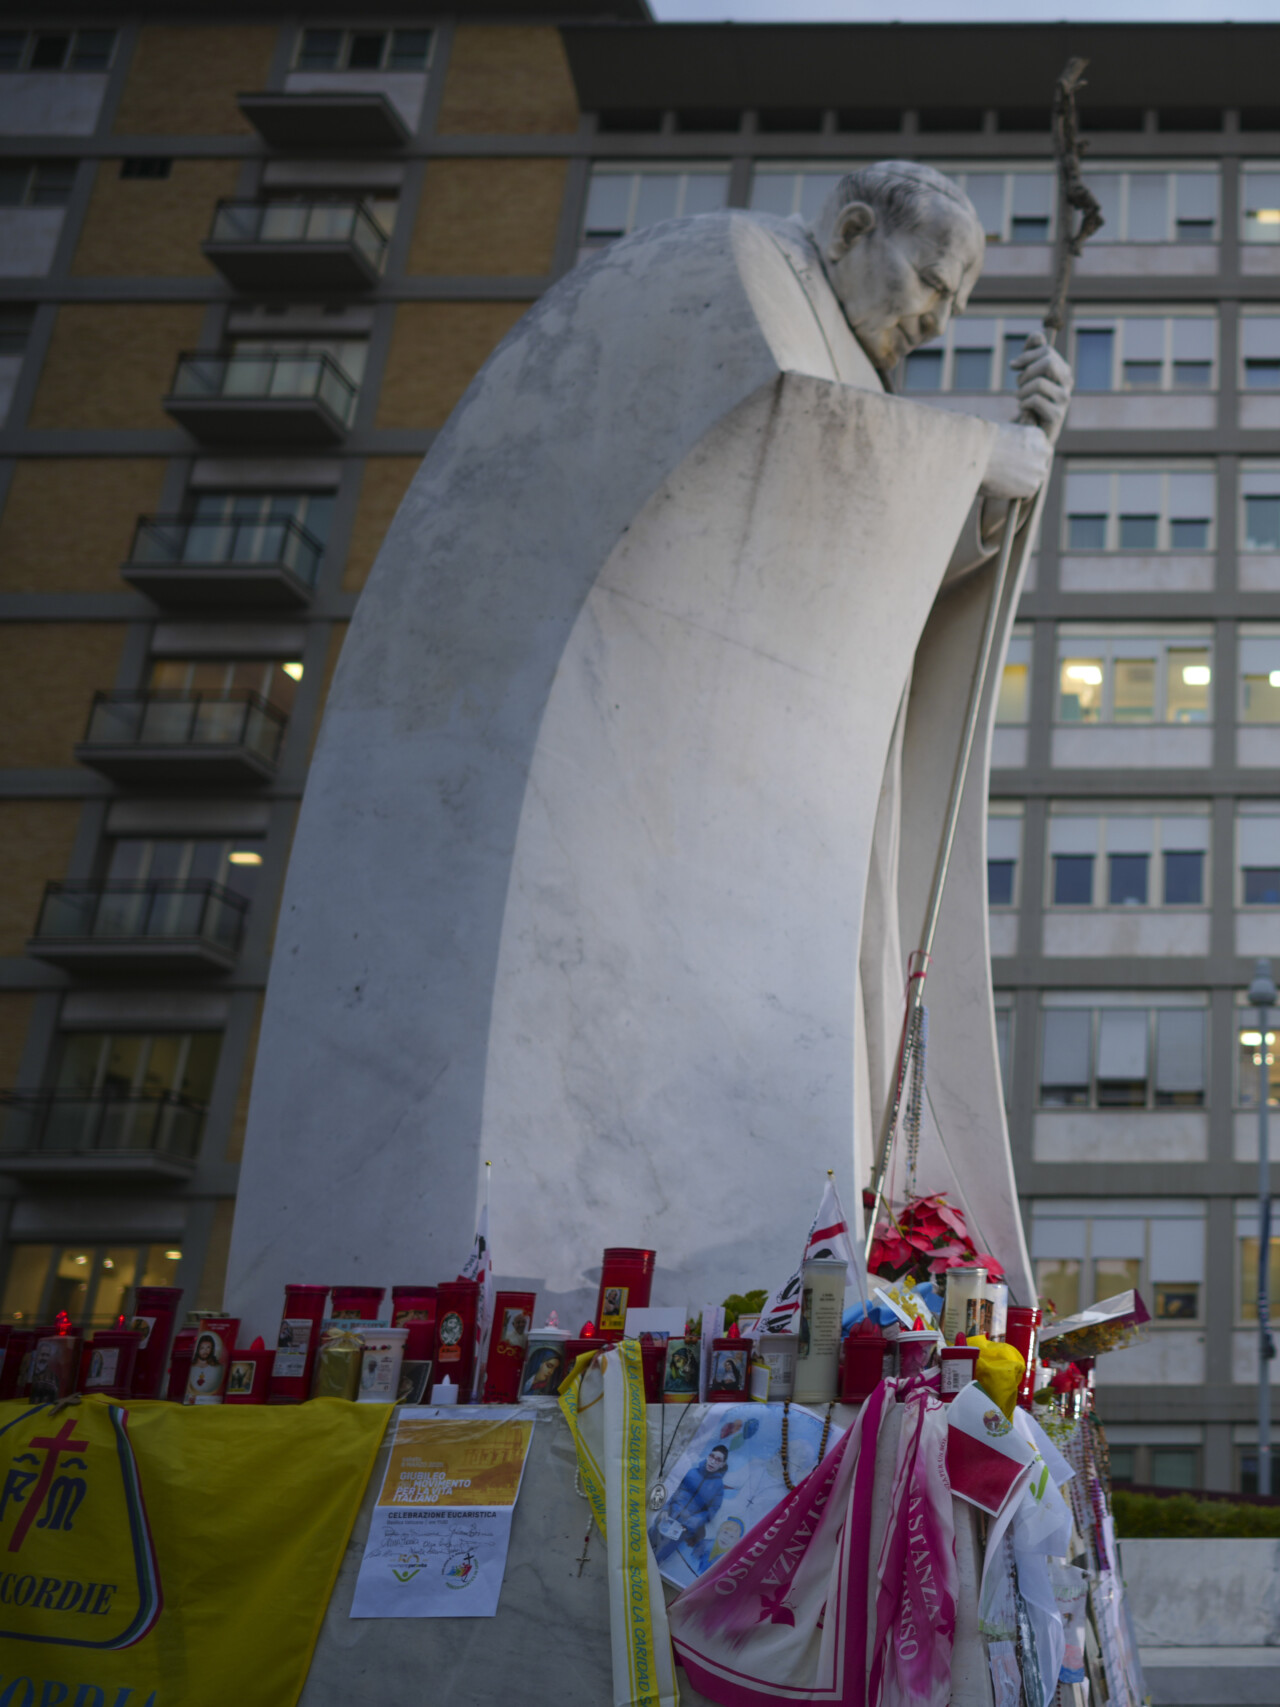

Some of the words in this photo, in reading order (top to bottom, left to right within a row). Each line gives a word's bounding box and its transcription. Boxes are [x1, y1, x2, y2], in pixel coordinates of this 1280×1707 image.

[400, 1472, 446, 1480] GIUBILEO
[414, 1479, 471, 1488] MOVIMENTO
[396, 1487, 416, 1495] PER
[417, 1487, 430, 1495] LA
[431, 1487, 453, 1495] VITA
[392, 1494, 440, 1503] ITALIANO
[388, 1511, 446, 1519] CELEBRAZIONE
[447, 1511, 497, 1519] EUCARISTICA
[628, 1498, 642, 1552] MONDO
[760, 1491, 829, 1585] STANZA
[0, 1571, 118, 1616] CORDIE
[632, 1606, 645, 1622] LA
[634, 1628, 650, 1692] CARIDAD
